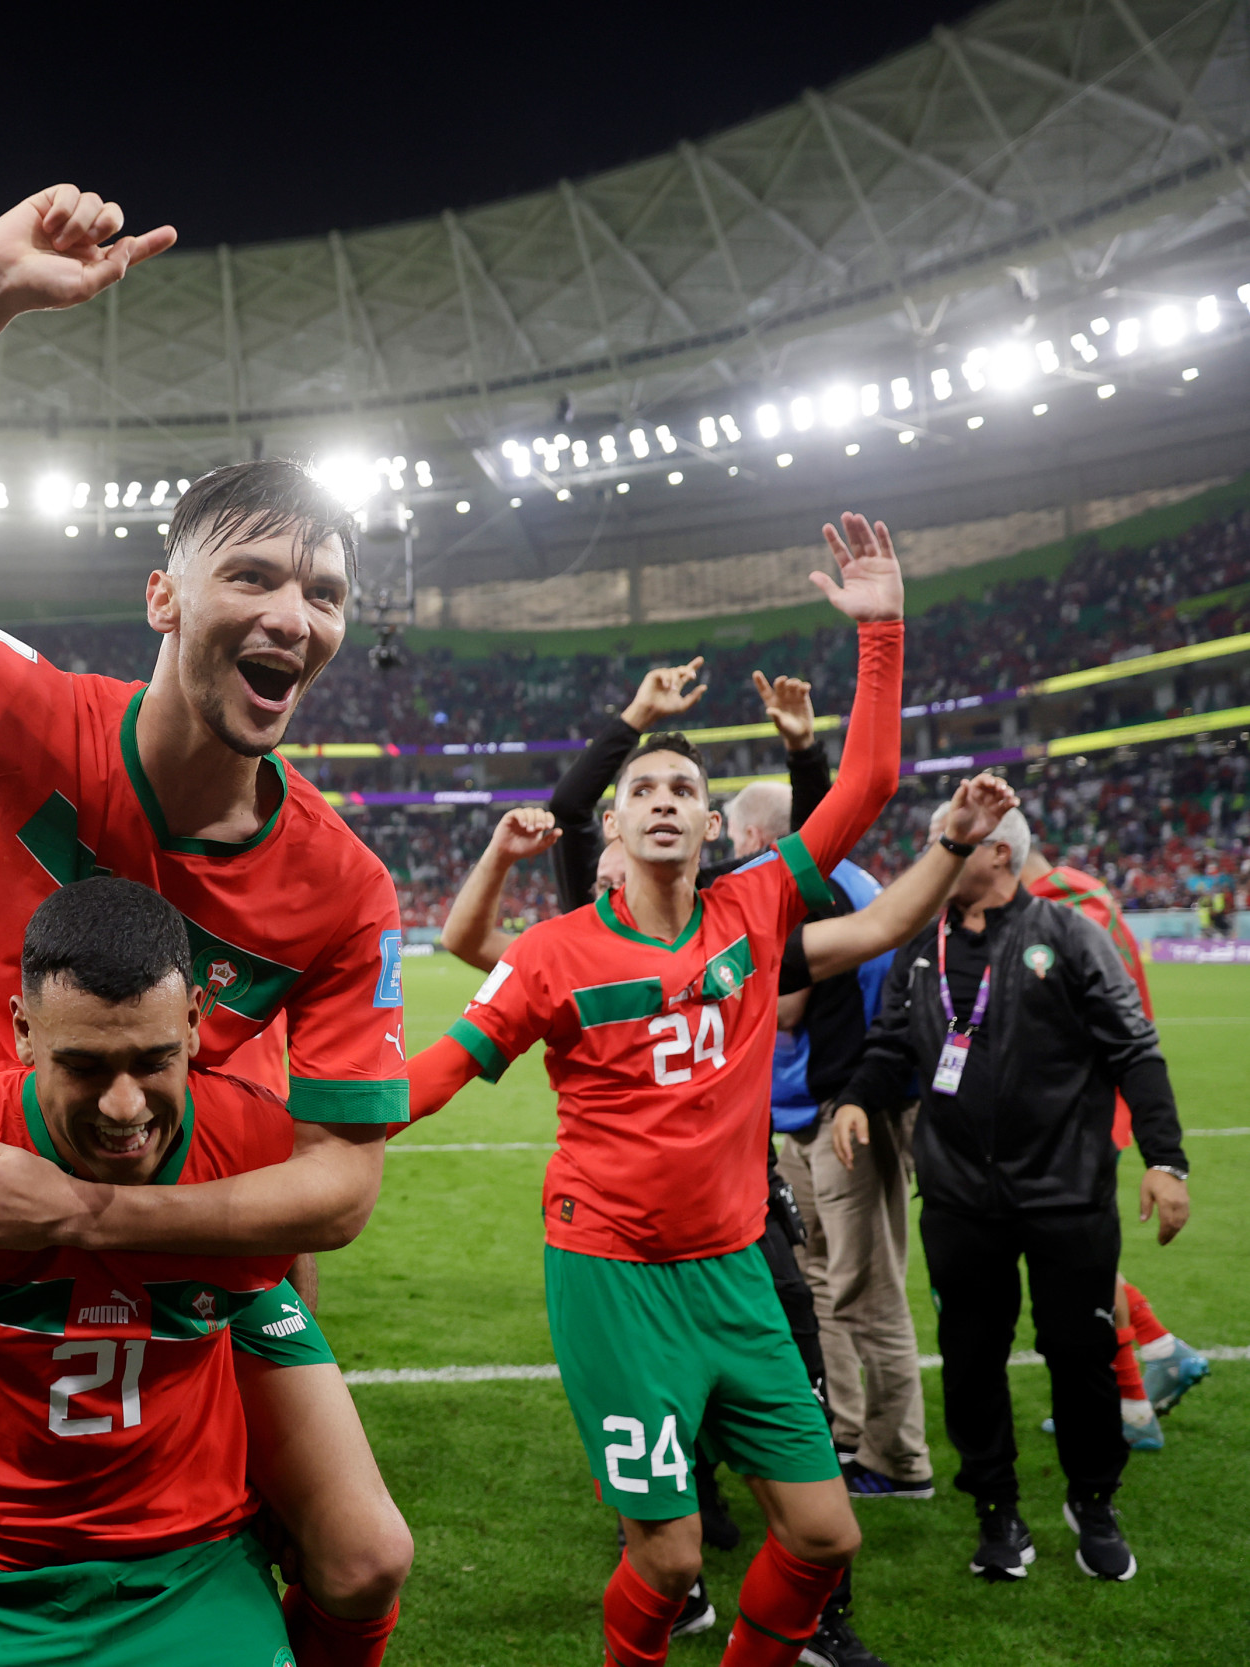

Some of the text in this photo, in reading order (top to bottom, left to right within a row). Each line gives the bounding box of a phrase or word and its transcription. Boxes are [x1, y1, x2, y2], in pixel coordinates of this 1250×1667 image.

[648, 1003, 727, 1086] 24
[77, 1305, 129, 1324] PUMA
[49, 1339, 147, 1437] 21
[603, 1414, 688, 1494] 24
